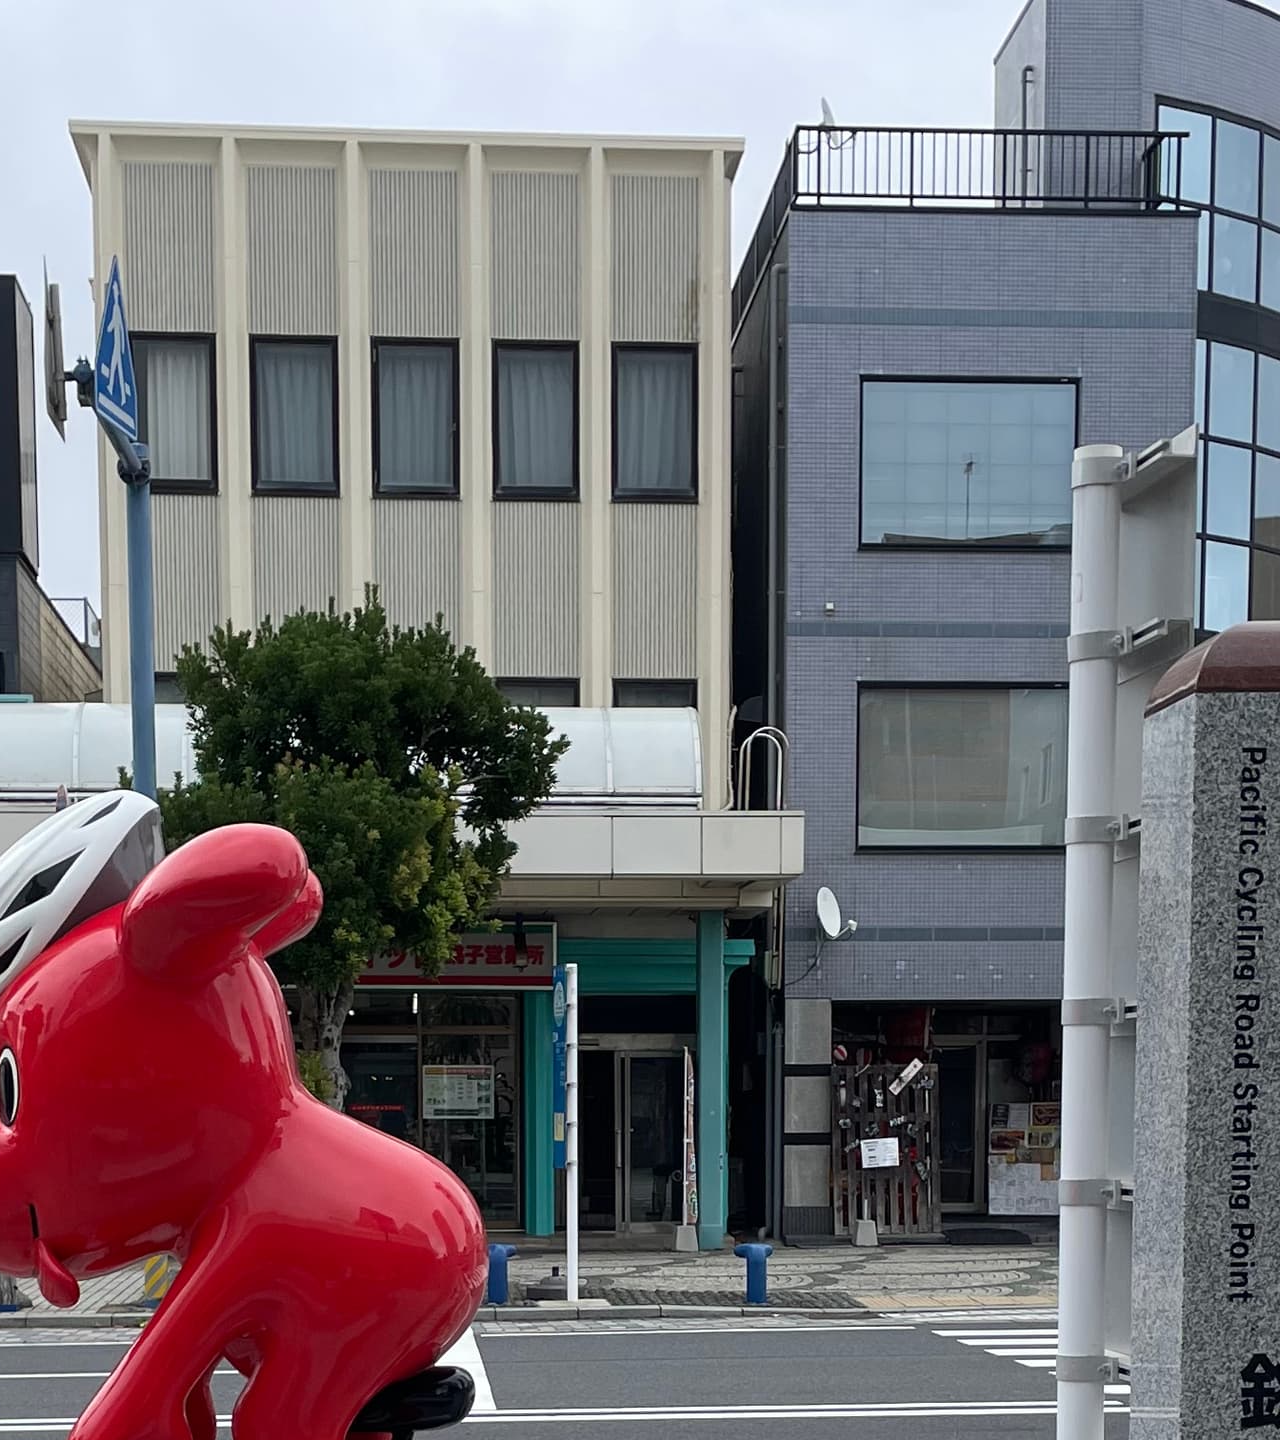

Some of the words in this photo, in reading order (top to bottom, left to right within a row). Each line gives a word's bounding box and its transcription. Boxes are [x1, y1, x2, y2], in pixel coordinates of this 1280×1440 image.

[1237, 747, 1268, 855] Pacific
[1232, 868, 1265, 981] Cycling
[1232, 993, 1261, 1070] Road
[1228, 1083, 1260, 1210] Starting
[1228, 1223, 1256, 1303] Point
